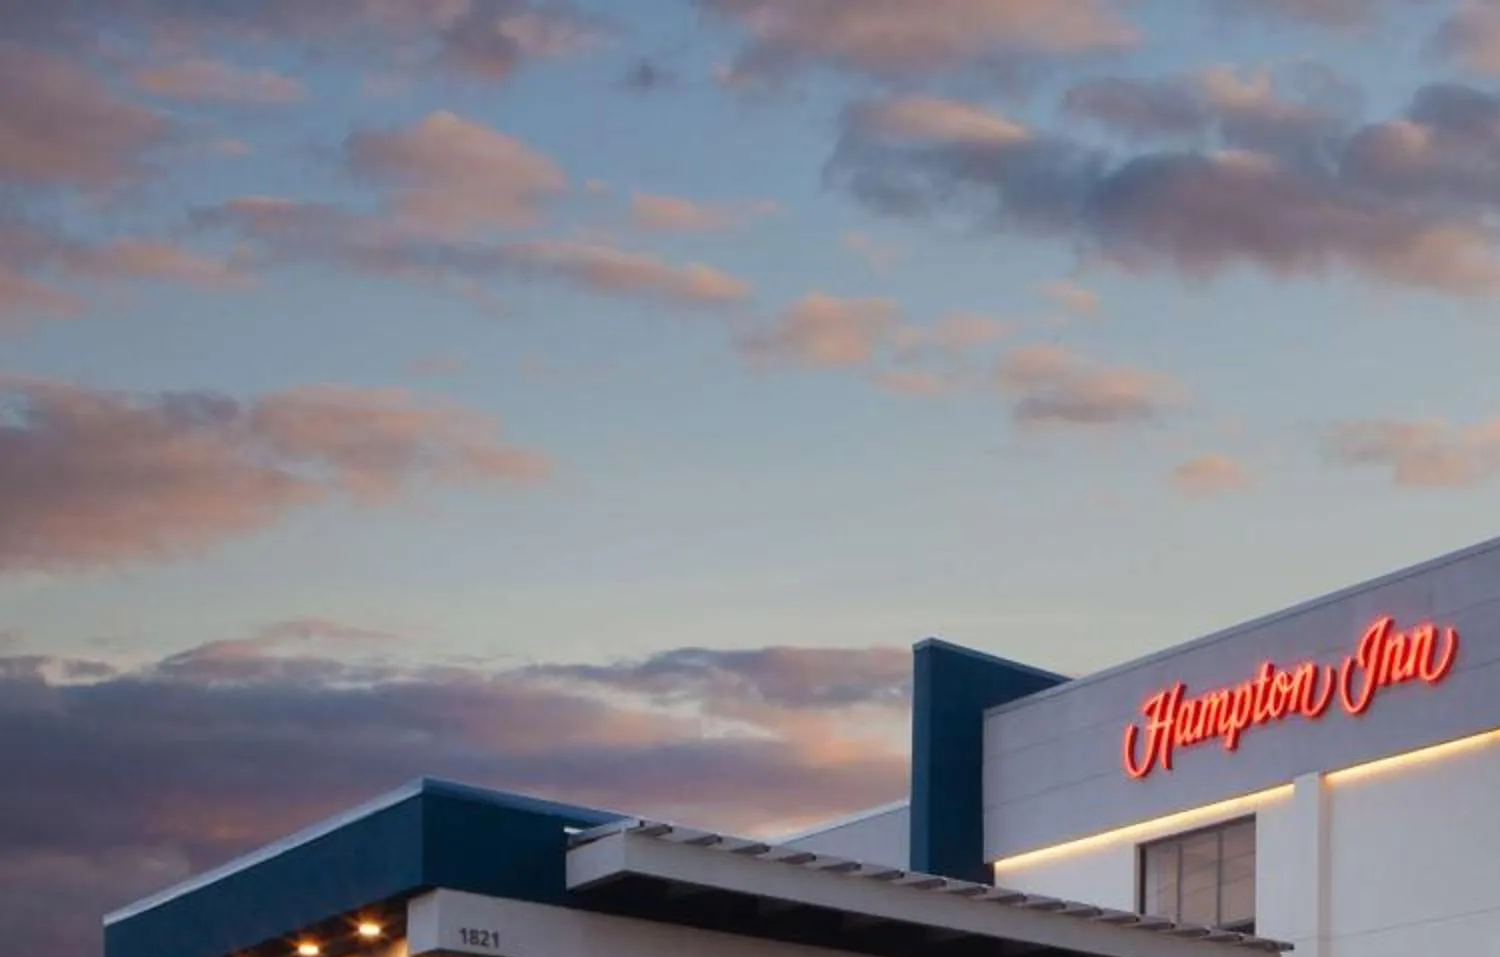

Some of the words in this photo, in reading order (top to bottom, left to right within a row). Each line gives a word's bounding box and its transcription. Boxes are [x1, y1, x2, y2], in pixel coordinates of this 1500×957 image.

[1123, 679, 1334, 781] Hampton
[1339, 614, 1461, 716] Inn
[458, 927, 499, 949] 1821
